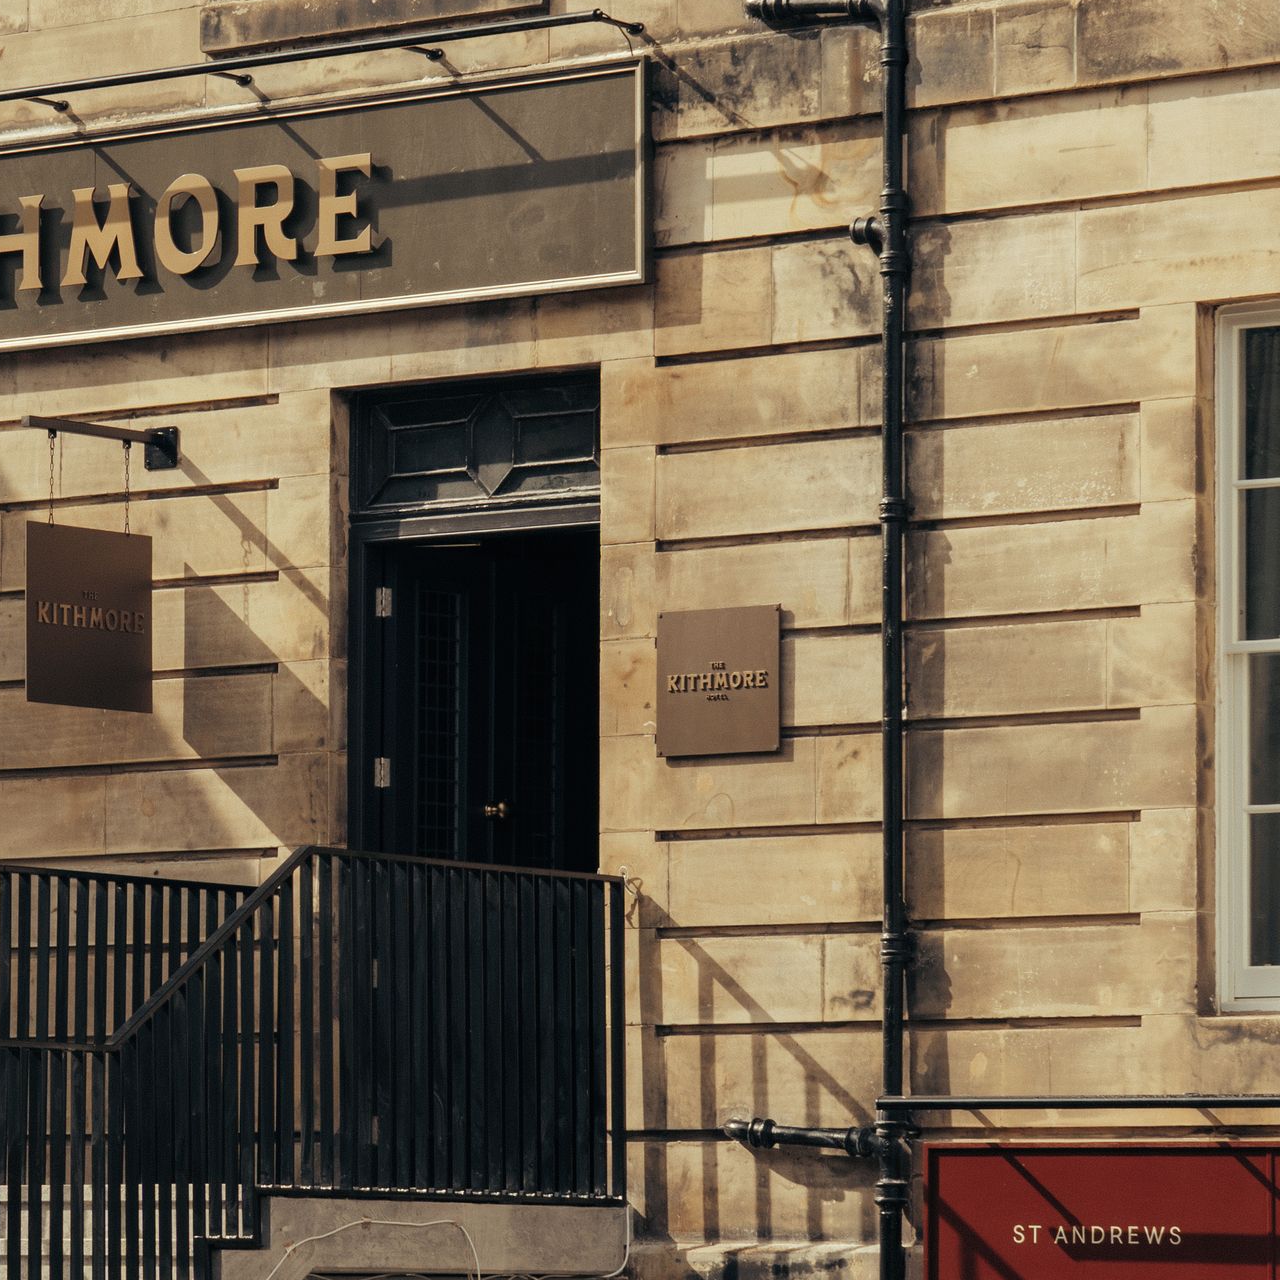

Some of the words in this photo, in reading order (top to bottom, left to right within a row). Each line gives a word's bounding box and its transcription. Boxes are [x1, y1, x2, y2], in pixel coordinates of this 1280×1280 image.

[83, 590, 99, 601] THE
[37, 600, 145, 634] KITHMORE
[667, 669, 768, 693] KITHMORE
[1013, 1224, 1042, 1244] ST
[1054, 1225, 1182, 1245] ANDREWS
